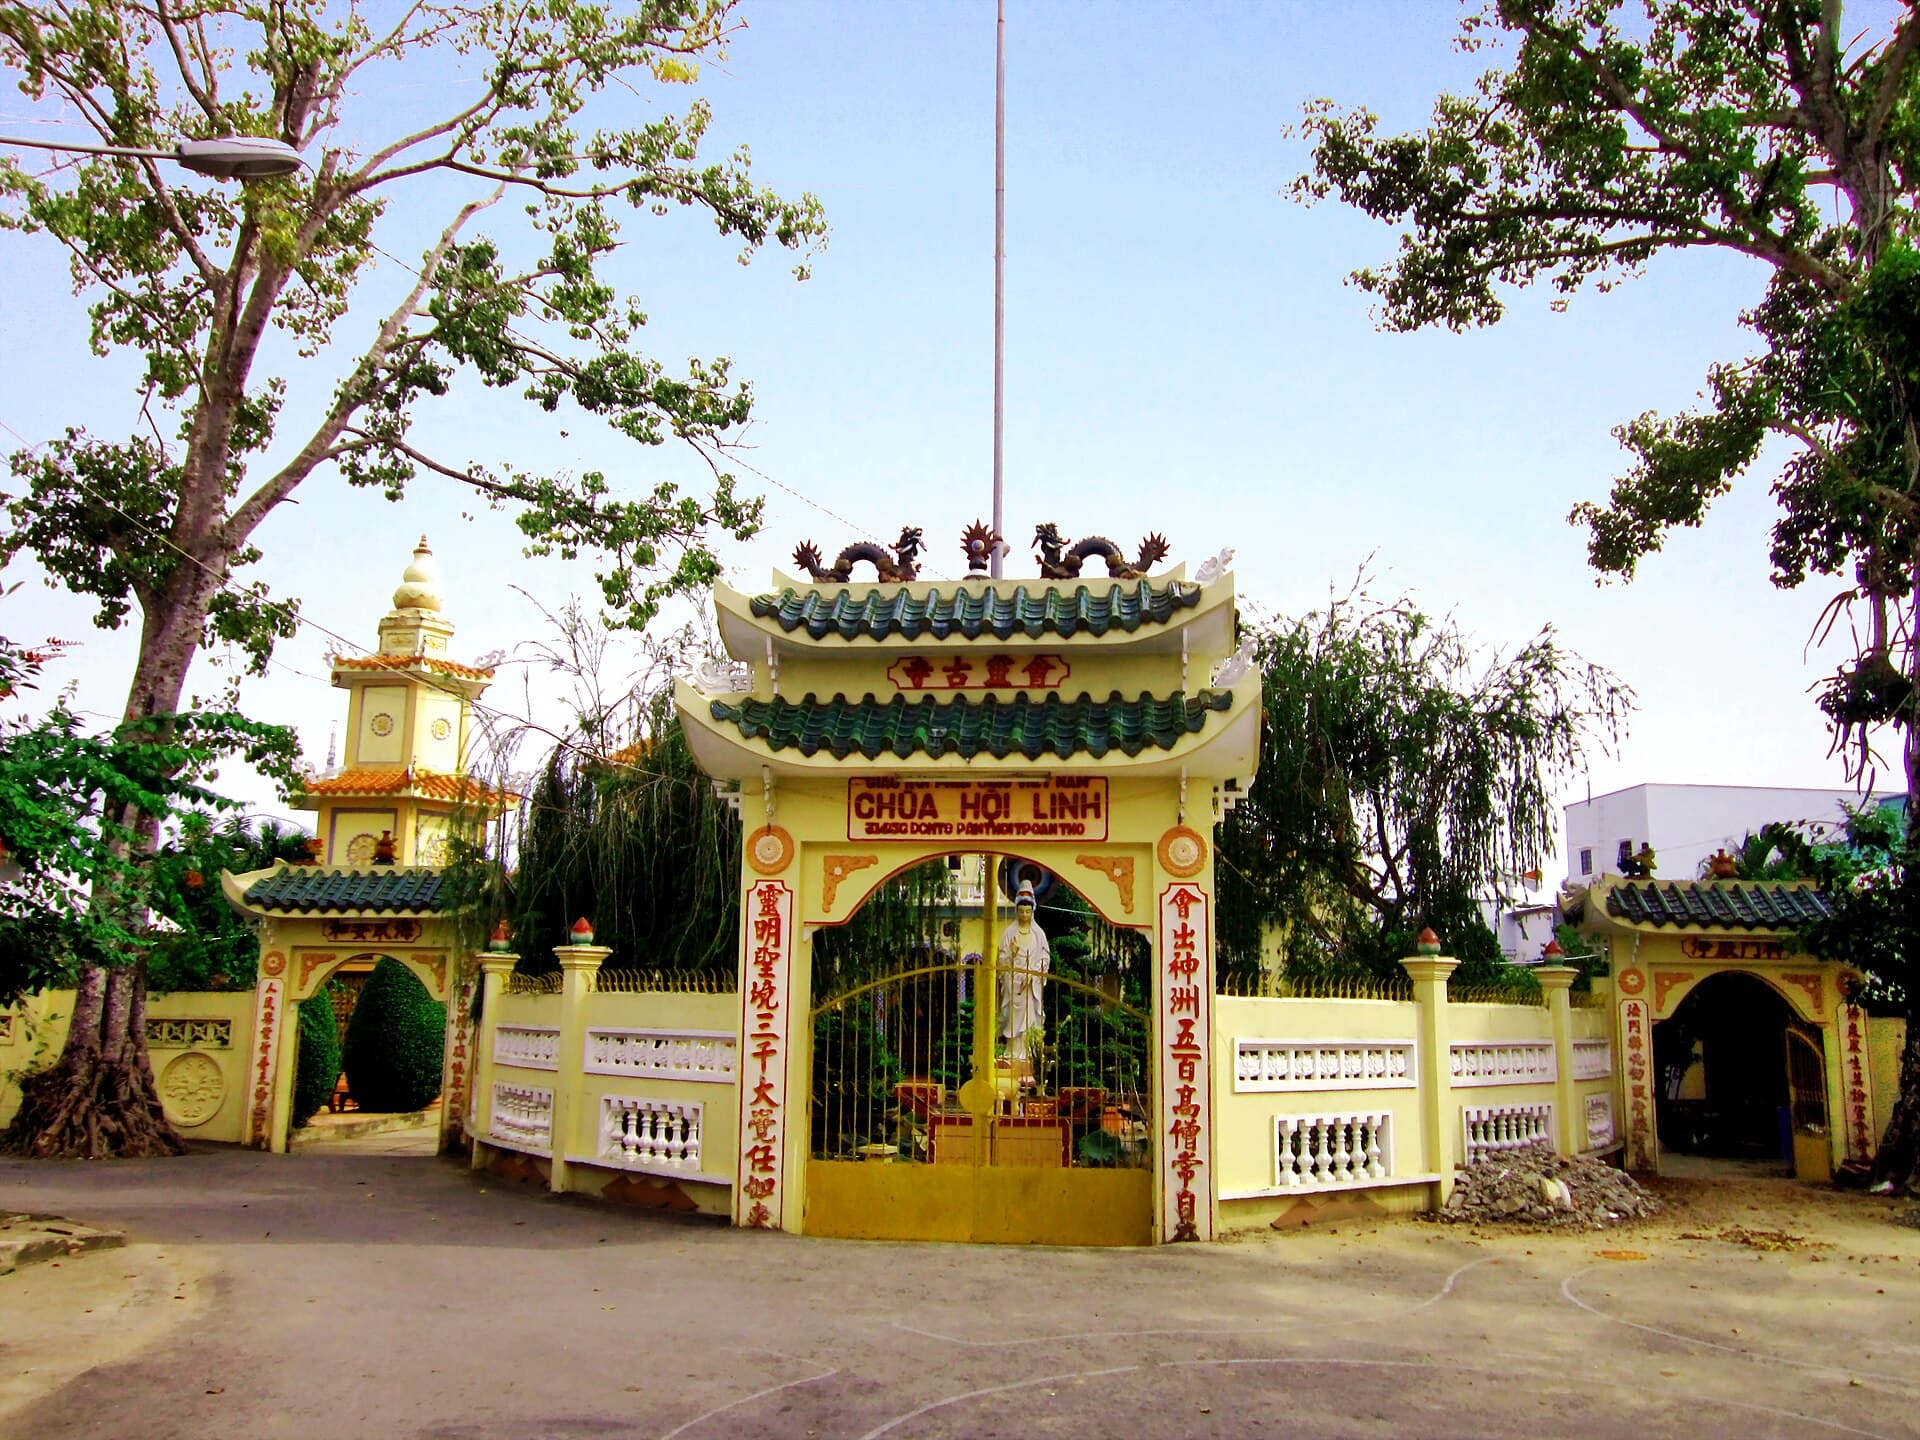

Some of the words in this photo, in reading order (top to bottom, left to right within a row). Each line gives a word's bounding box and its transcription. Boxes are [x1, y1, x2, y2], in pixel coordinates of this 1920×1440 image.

[855, 788, 938, 819] CHÙA
[960, 789, 1011, 824] HỘI
[1033, 791, 1101, 819] LINH
